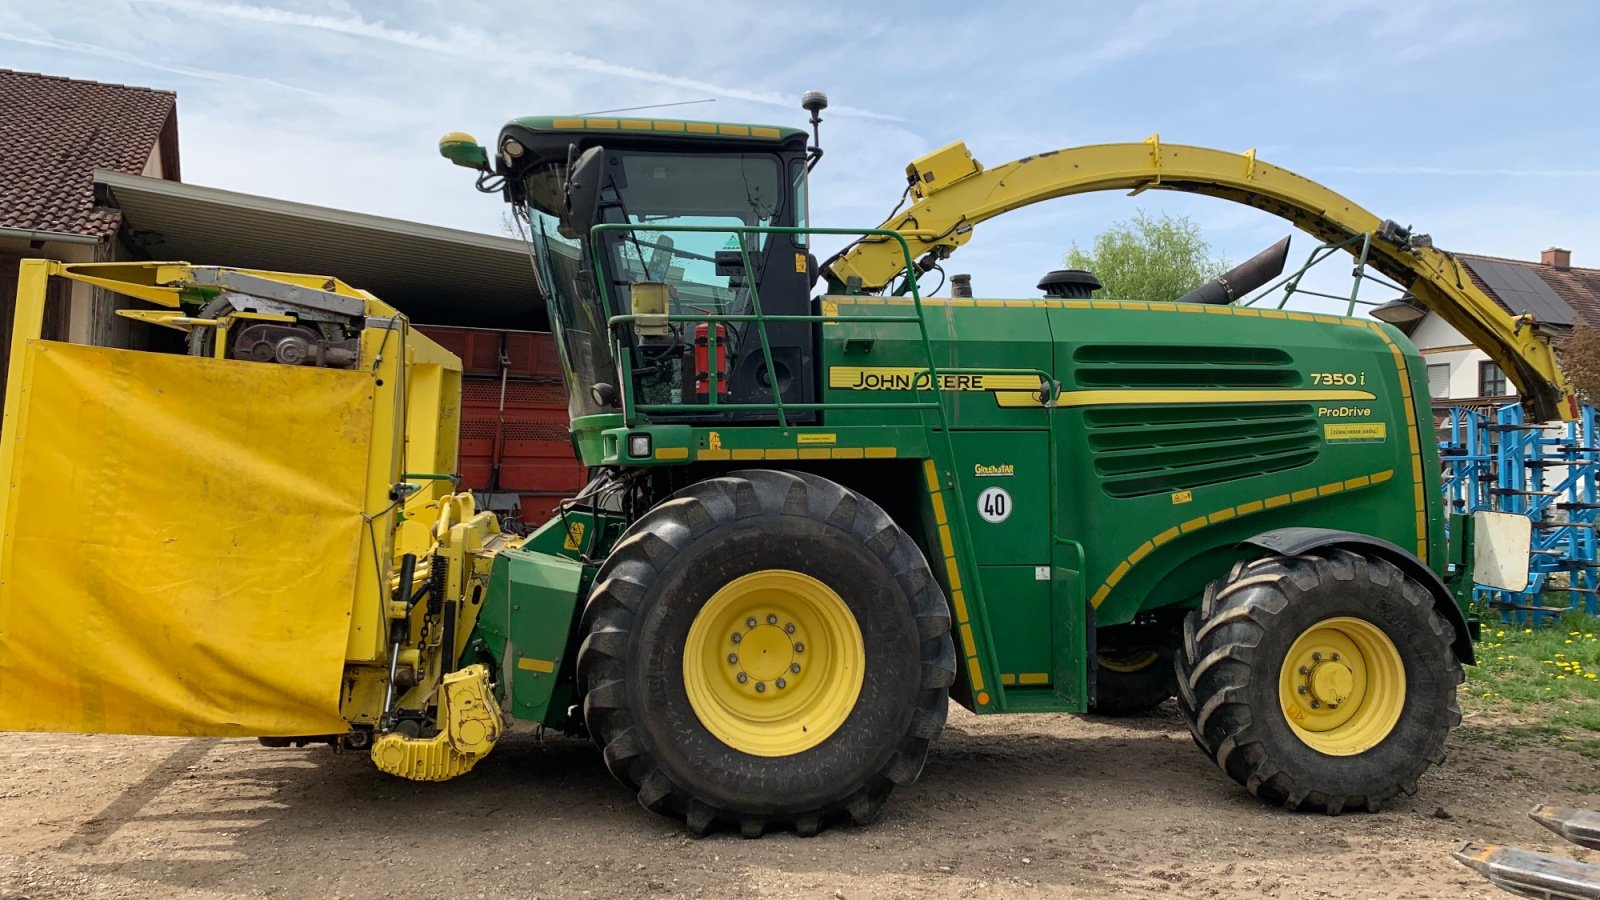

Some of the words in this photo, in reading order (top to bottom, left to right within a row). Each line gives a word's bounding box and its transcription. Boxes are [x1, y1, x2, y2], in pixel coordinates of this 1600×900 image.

[853, 371, 910, 388] JOHN
[1310, 373, 1357, 386] 7350
[1318, 406, 1371, 417] ProDrive
[984, 493, 1005, 516] 40
